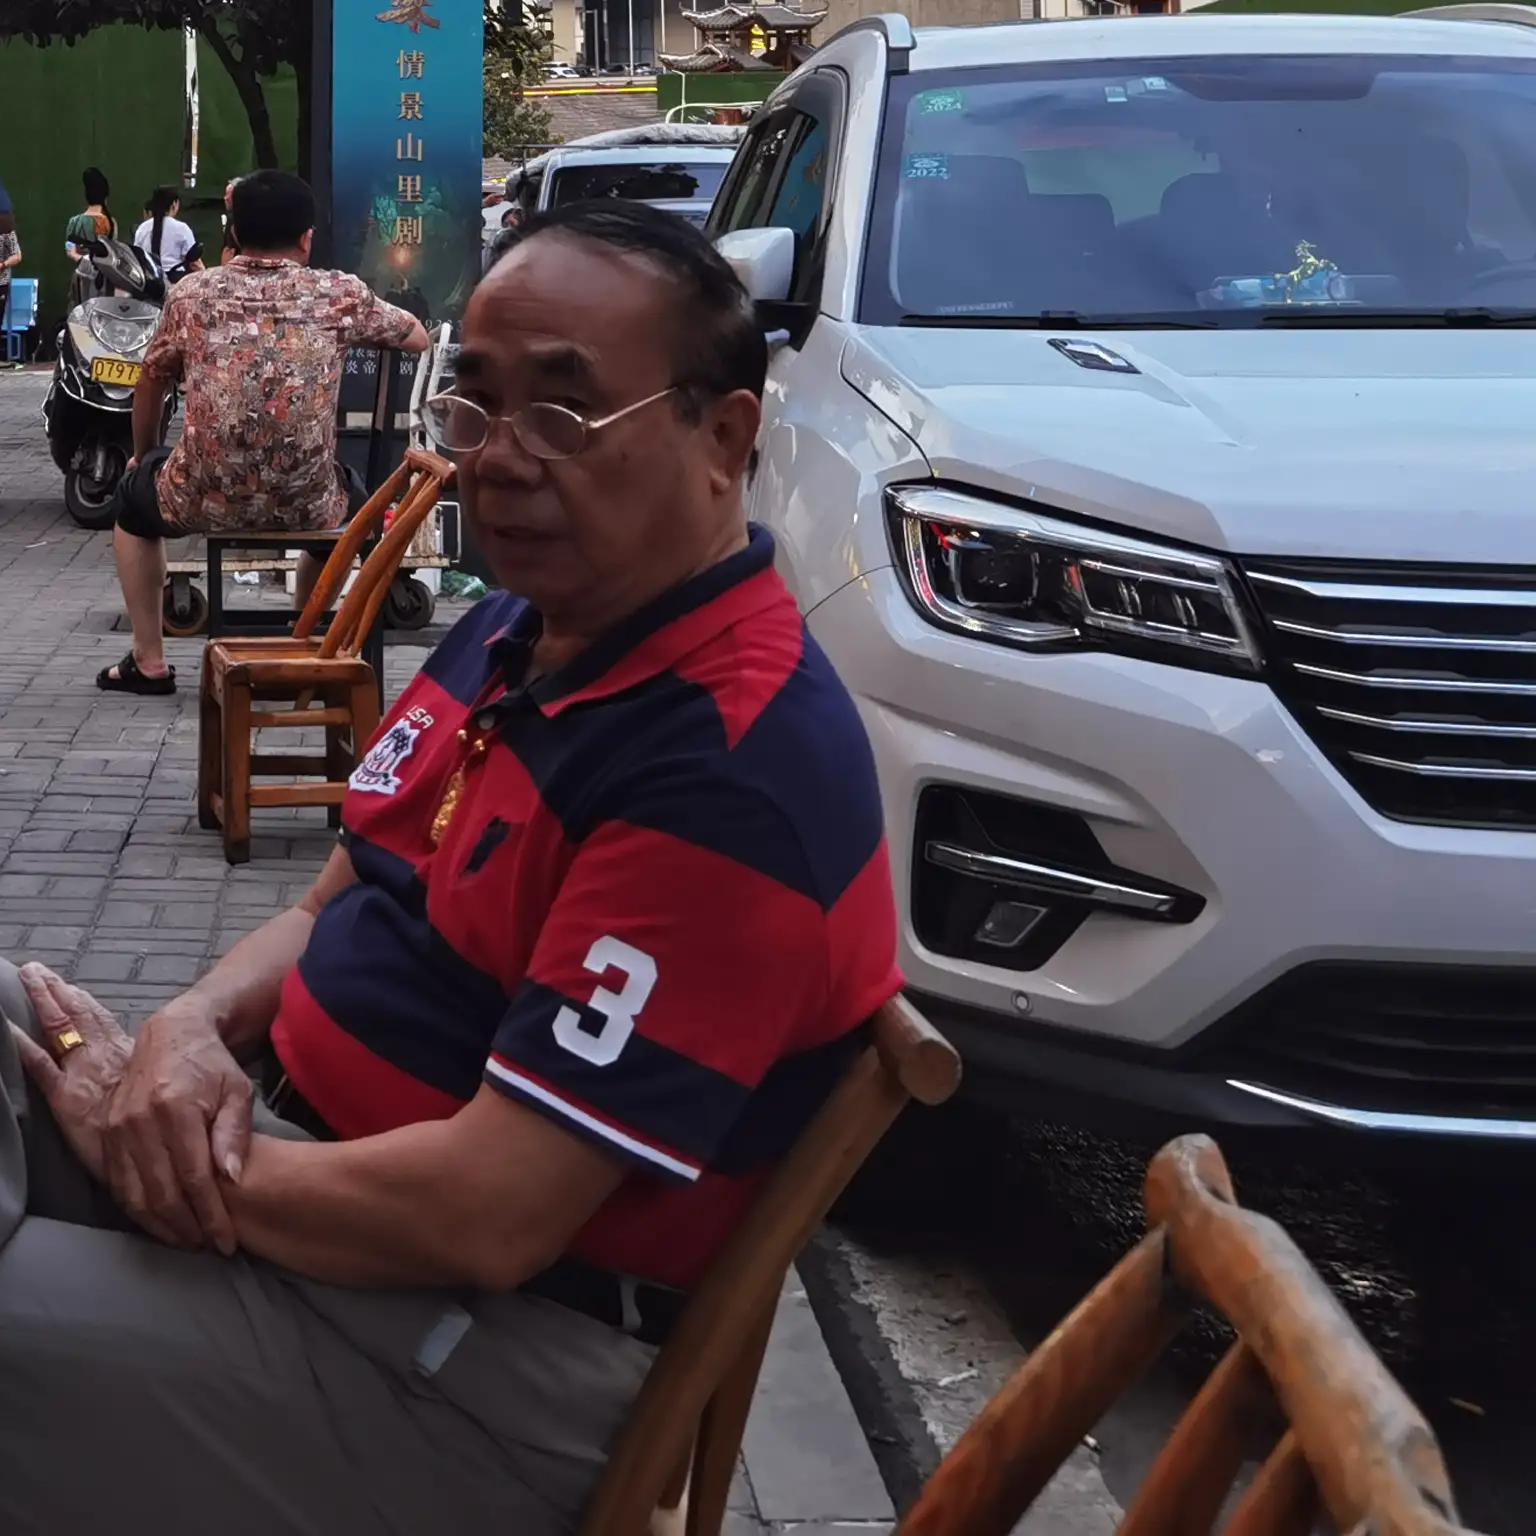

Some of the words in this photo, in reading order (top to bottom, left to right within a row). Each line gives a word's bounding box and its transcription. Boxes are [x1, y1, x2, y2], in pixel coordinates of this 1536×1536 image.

[925, 101, 963, 113] 2024
[392, 49, 426, 246] 情景山里剧
[907, 167, 949, 179] 2022
[552, 935, 658, 1066] 3
